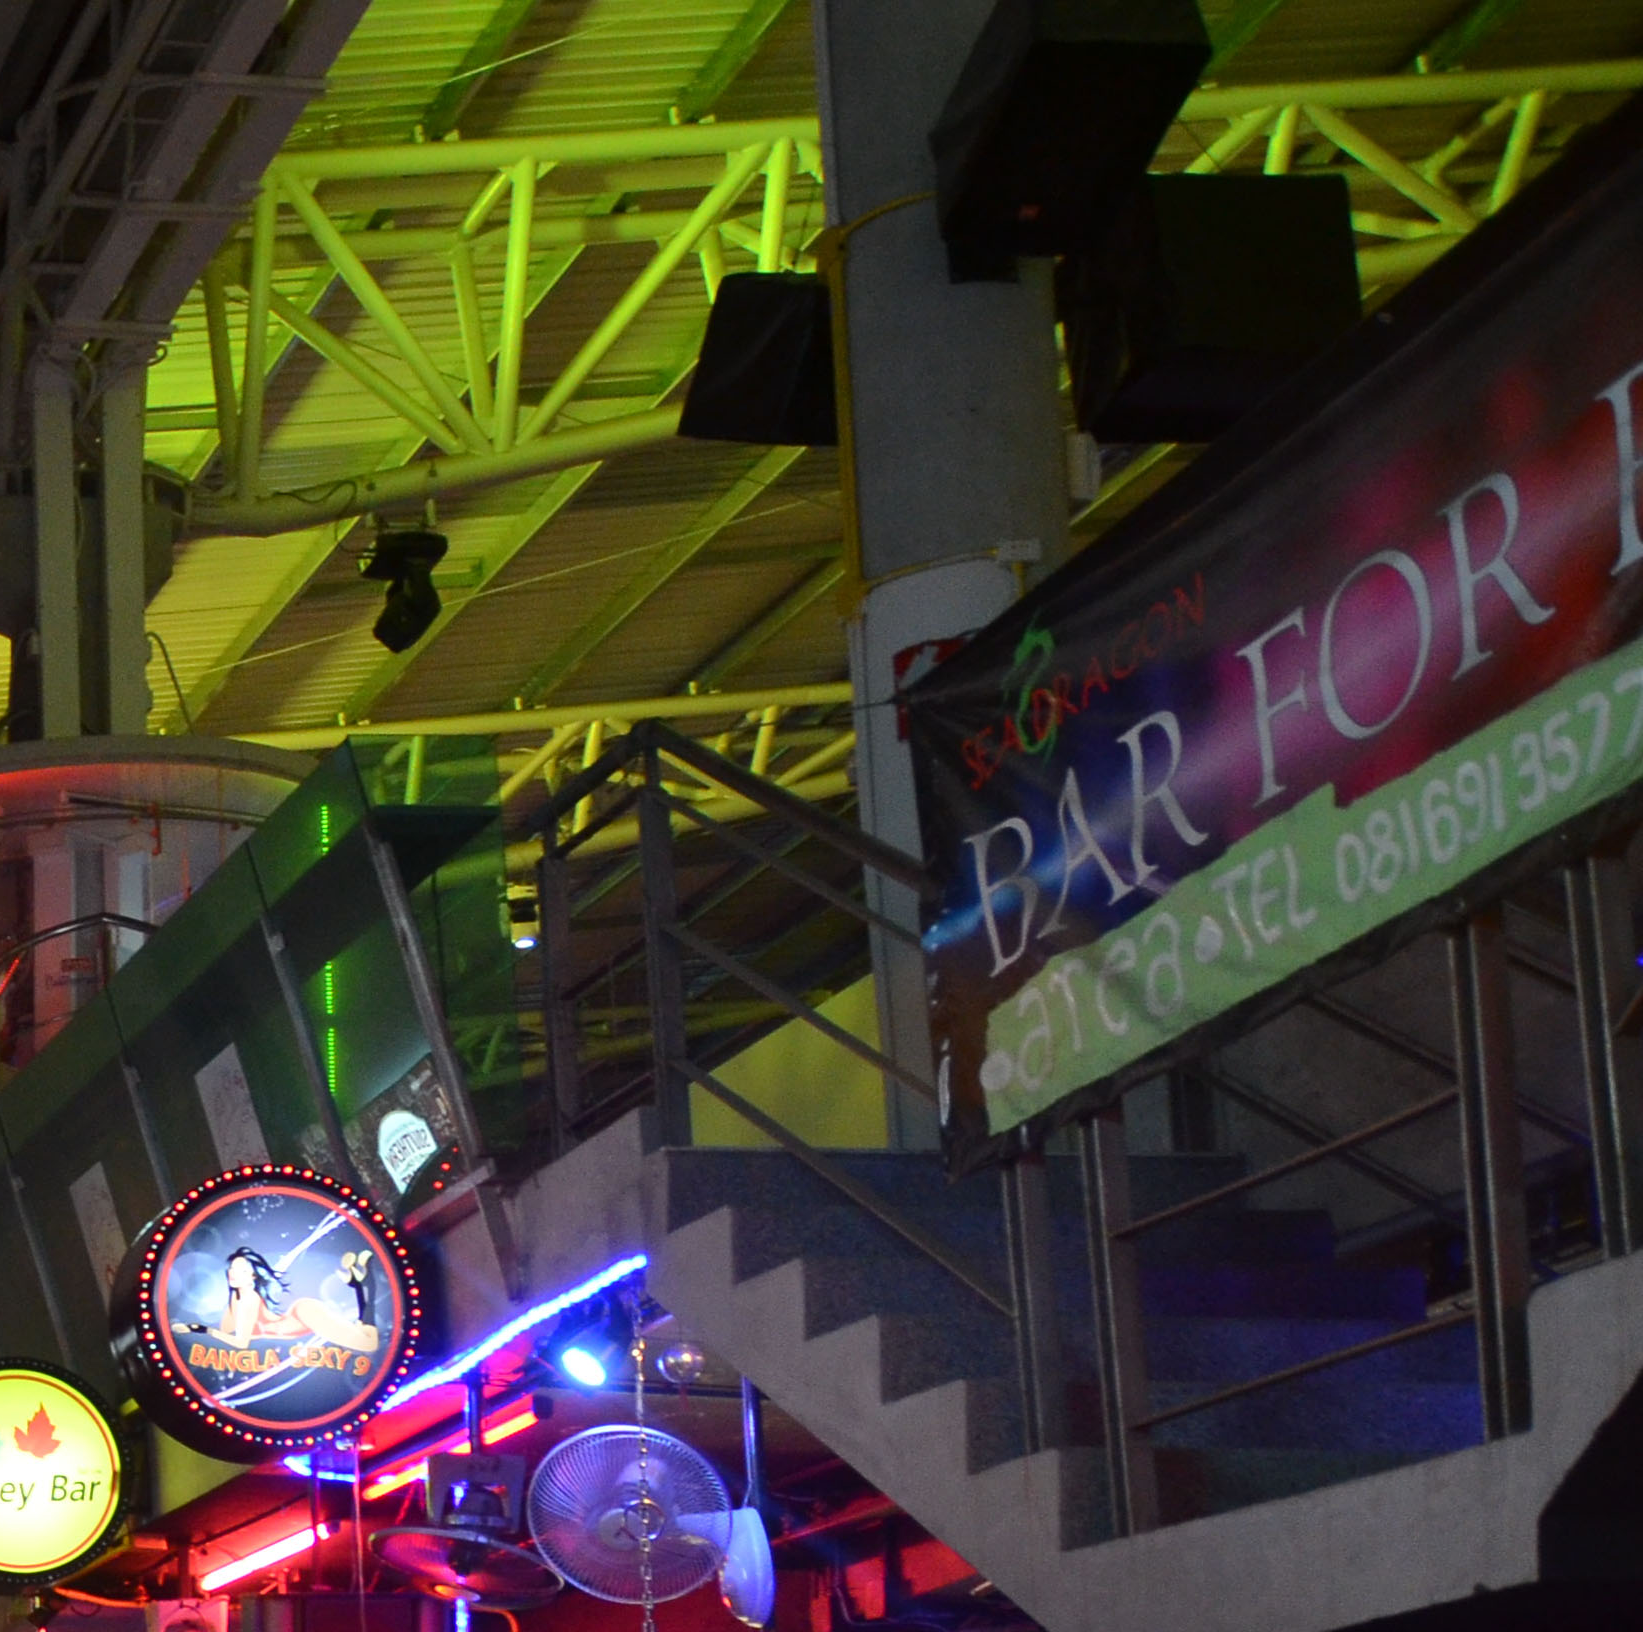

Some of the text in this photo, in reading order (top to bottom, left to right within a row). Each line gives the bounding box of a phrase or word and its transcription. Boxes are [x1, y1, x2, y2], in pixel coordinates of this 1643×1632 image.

[962, 471, 1557, 979] BAR FOR
[189, 1342, 372, 1377] BANGLA SEXY 9
[51, 1475, 102, 1502] Bar
